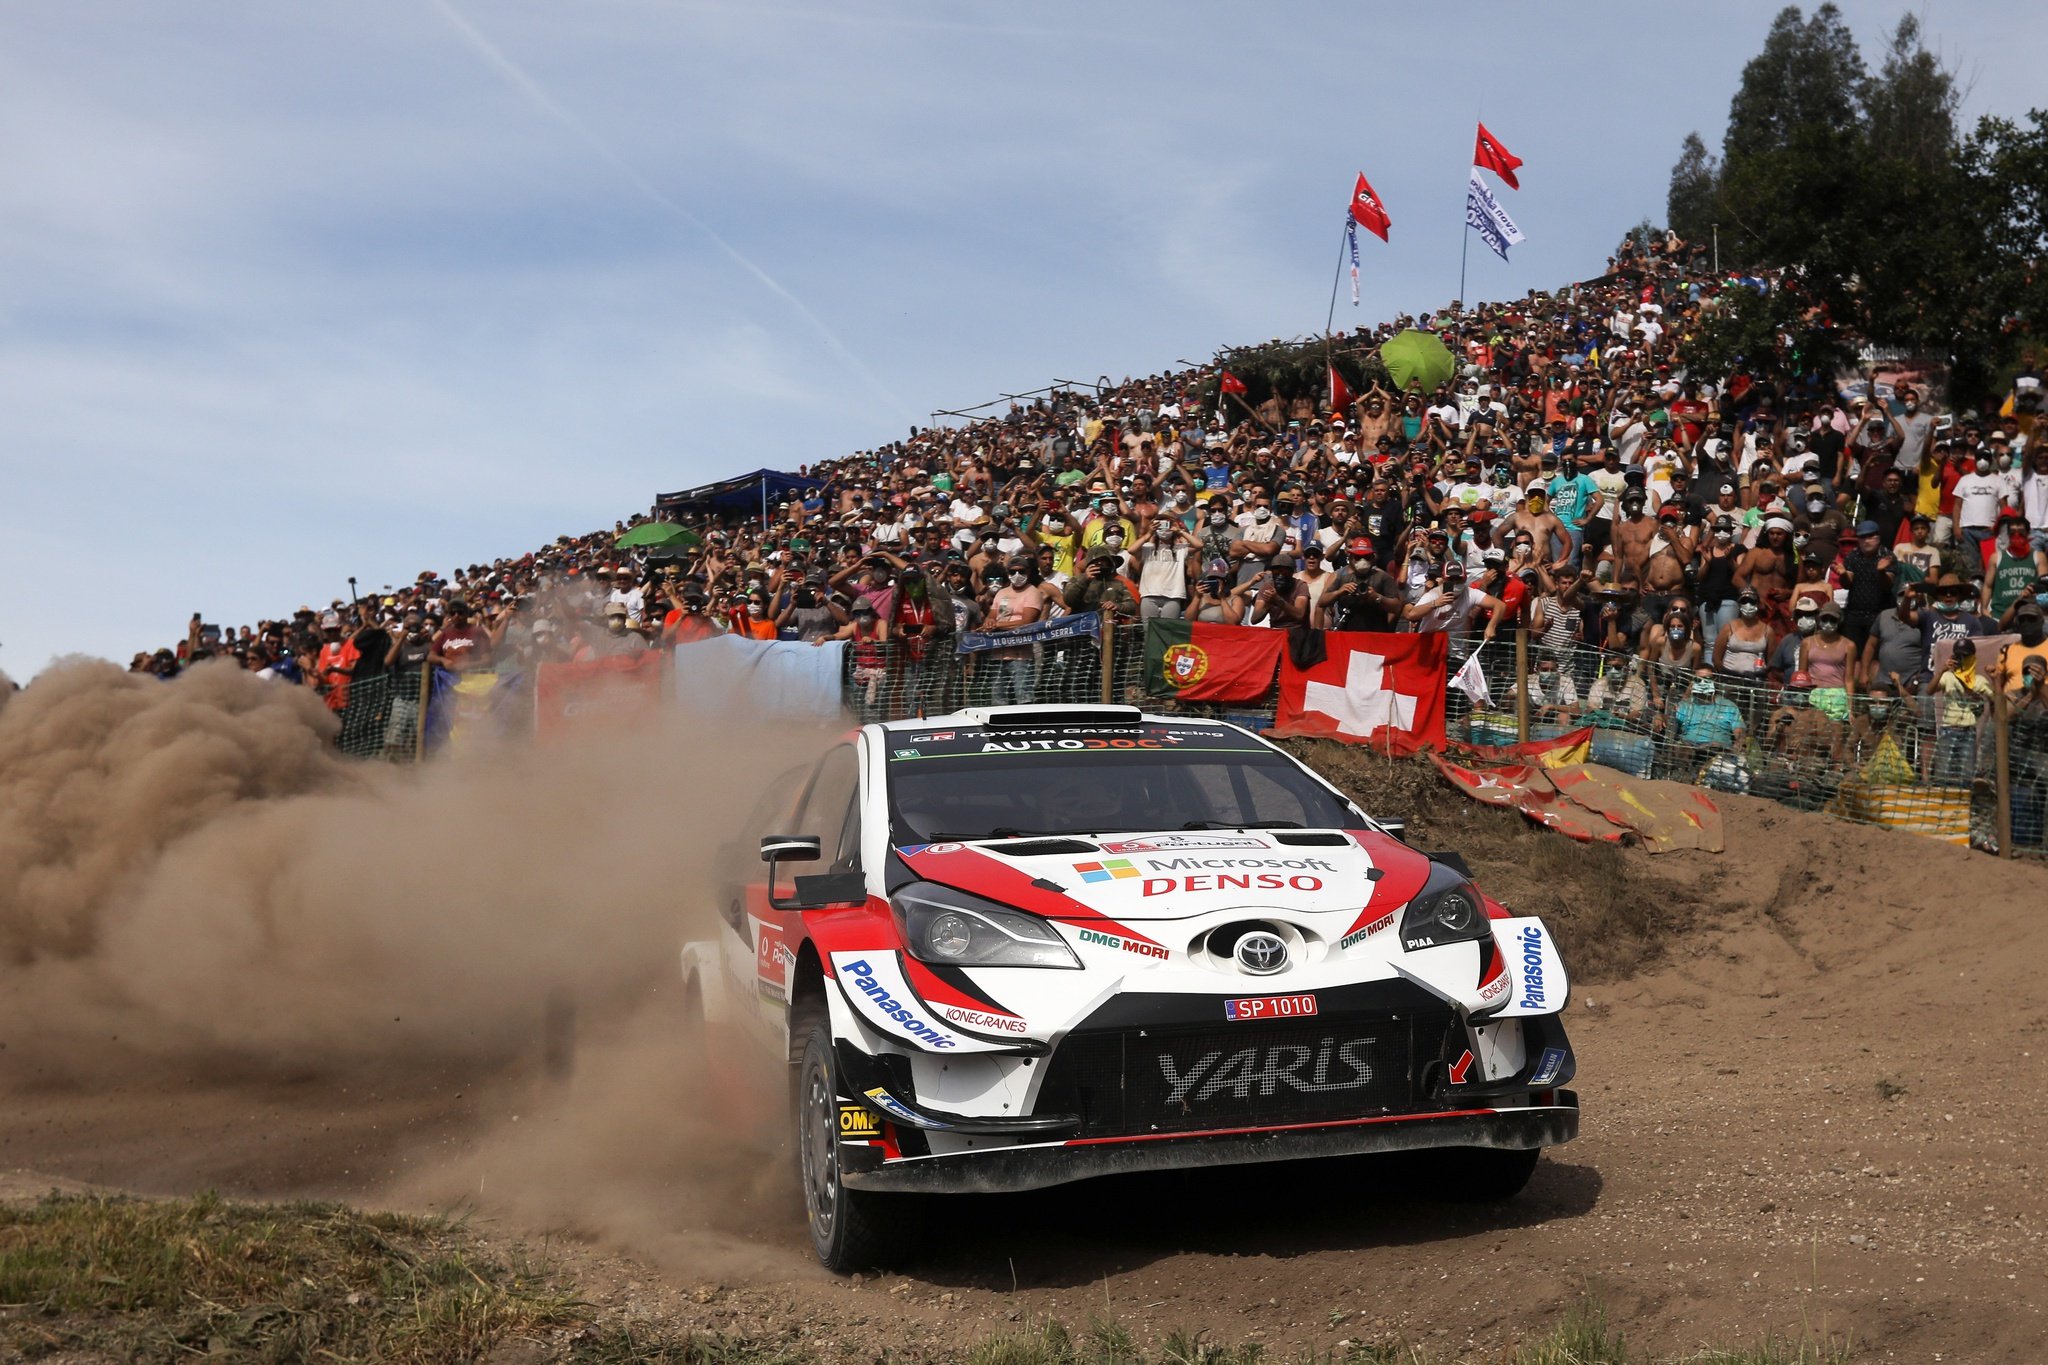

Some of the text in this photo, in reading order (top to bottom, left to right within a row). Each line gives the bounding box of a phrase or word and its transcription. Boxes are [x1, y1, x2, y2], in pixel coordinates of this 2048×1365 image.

[1495, 210, 1518, 234] nova
[2009, 576, 2025, 588] 06
[1050, 627, 1074, 638] SERRA
[962, 729, 1056, 738] TOYOTA
[1151, 729, 1225, 738] Racing
[1146, 857, 1338, 872] Microsoft
[1143, 873, 1323, 897] DENSO
[1341, 914, 1395, 951] DMG MORI
[1406, 936, 1434, 949] PIAA
[1079, 929, 1170, 960] DMG MORI
[1516, 927, 1547, 1010] Panasonic
[842, 959, 956, 1049] Panasonic
[1239, 997, 1313, 1017] SP 1010
[945, 1007, 1027, 1033] KONECRANES
[840, 1111, 880, 1130] OMP
